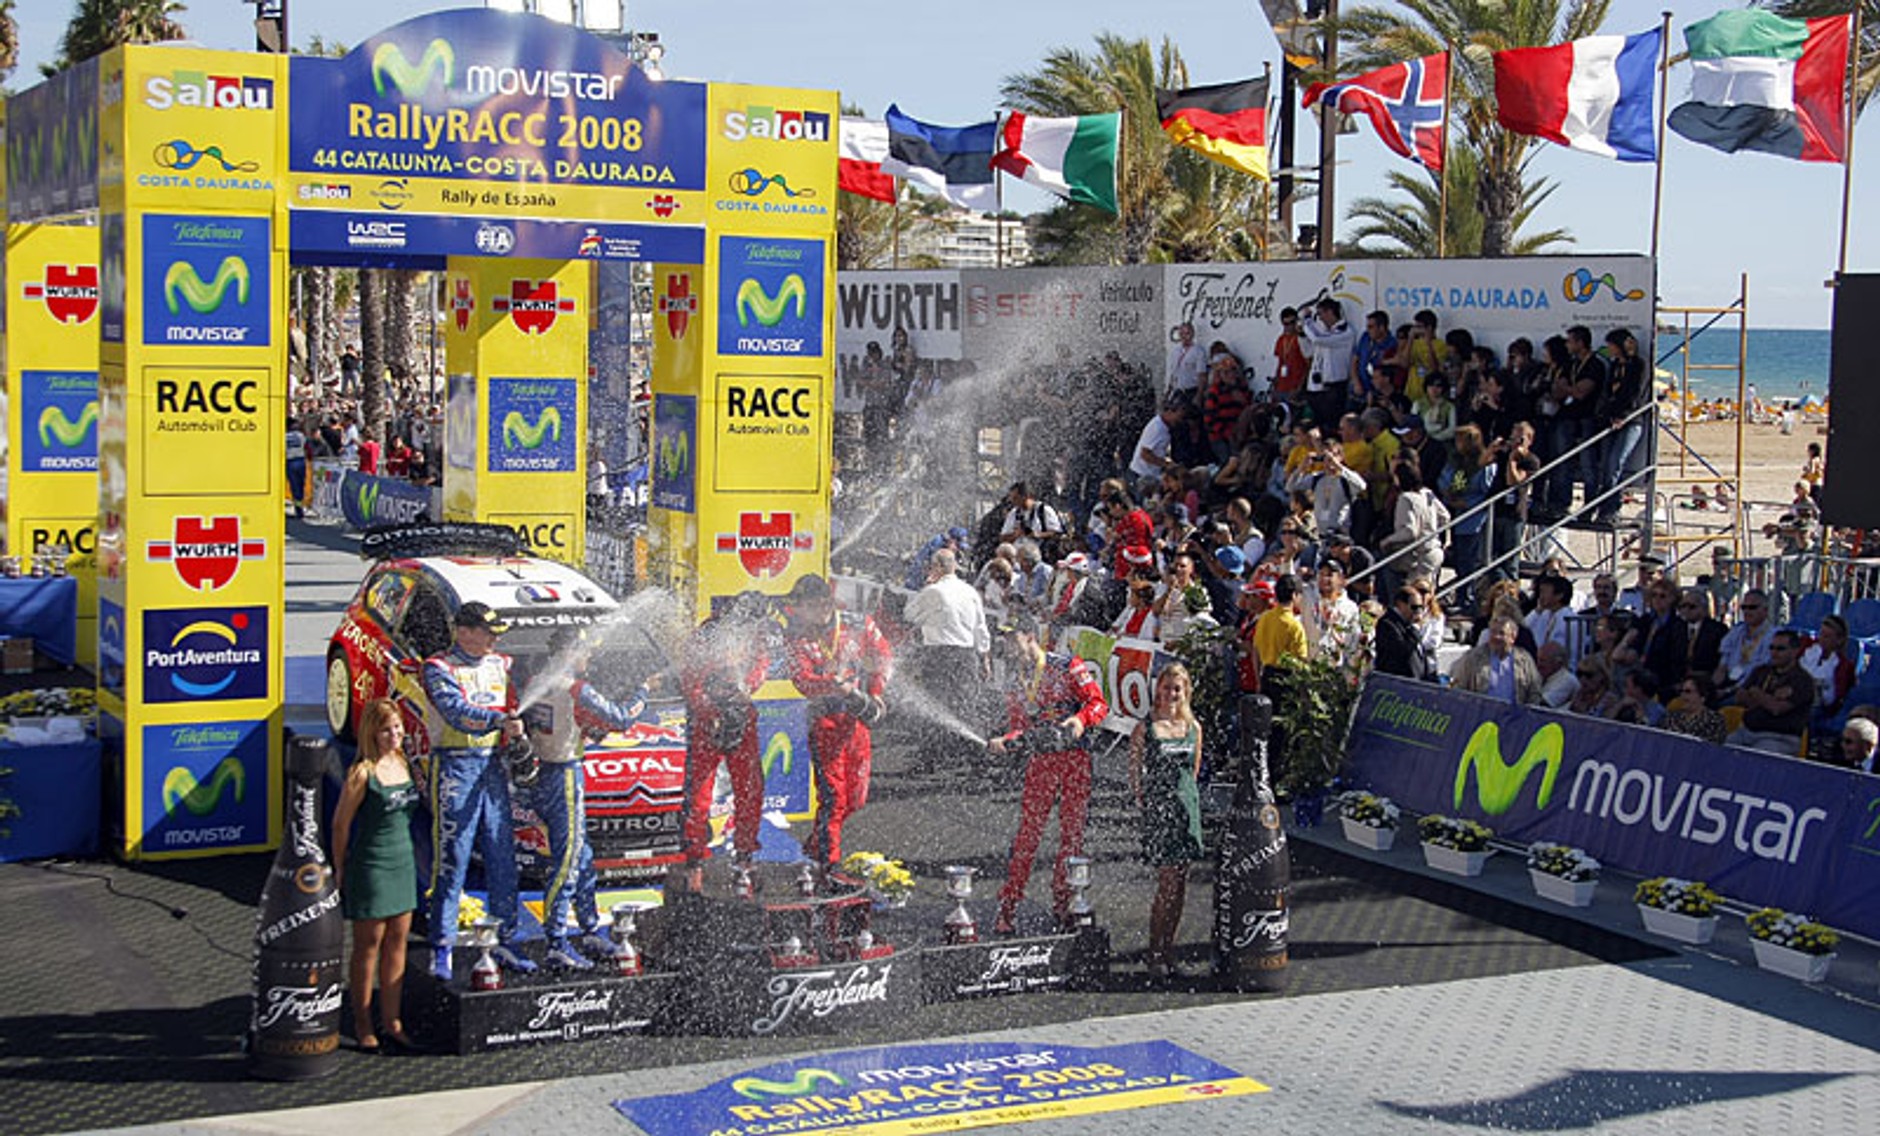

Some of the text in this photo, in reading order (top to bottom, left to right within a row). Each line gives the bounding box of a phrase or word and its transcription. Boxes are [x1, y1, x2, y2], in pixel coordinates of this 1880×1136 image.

[145, 76, 270, 110] Salou
[467, 65, 623, 101] movistar
[348, 103, 643, 151] RallyRACC 2008
[723, 111, 826, 141] Salou
[313, 149, 337, 167] 44
[555, 160, 676, 183] DAURADA
[138, 174, 274, 190] COSTA DAURADA
[299, 184, 350, 199] Salou
[441, 190, 557, 207] Rally de España
[716, 200, 827, 215] COSTA DAURADA
[838, 282, 958, 331] WÜRTH
[1384, 286, 1551, 309] COSTA DAURADA
[166, 326, 248, 342] movistar
[737, 338, 804, 352] movistar
[156, 380, 258, 414] RACC
[727, 386, 811, 419] RACC
[157, 419, 258, 432] Automóvil Club
[786, 423, 810, 436] Club
[33, 528, 97, 554] RAC
[514, 523, 566, 548] ACC
[147, 647, 261, 667] PortAventura
[1369, 687, 1452, 738] Telefónica
[583, 757, 684, 778] TOTAL
[1568, 757, 1828, 865] movistar
[164, 825, 245, 846] movistar
[751, 963, 893, 1034] Freixenet
[857, 1050, 1058, 1084] movistar
[727, 1062, 1126, 1122] RallyRACC 2008
